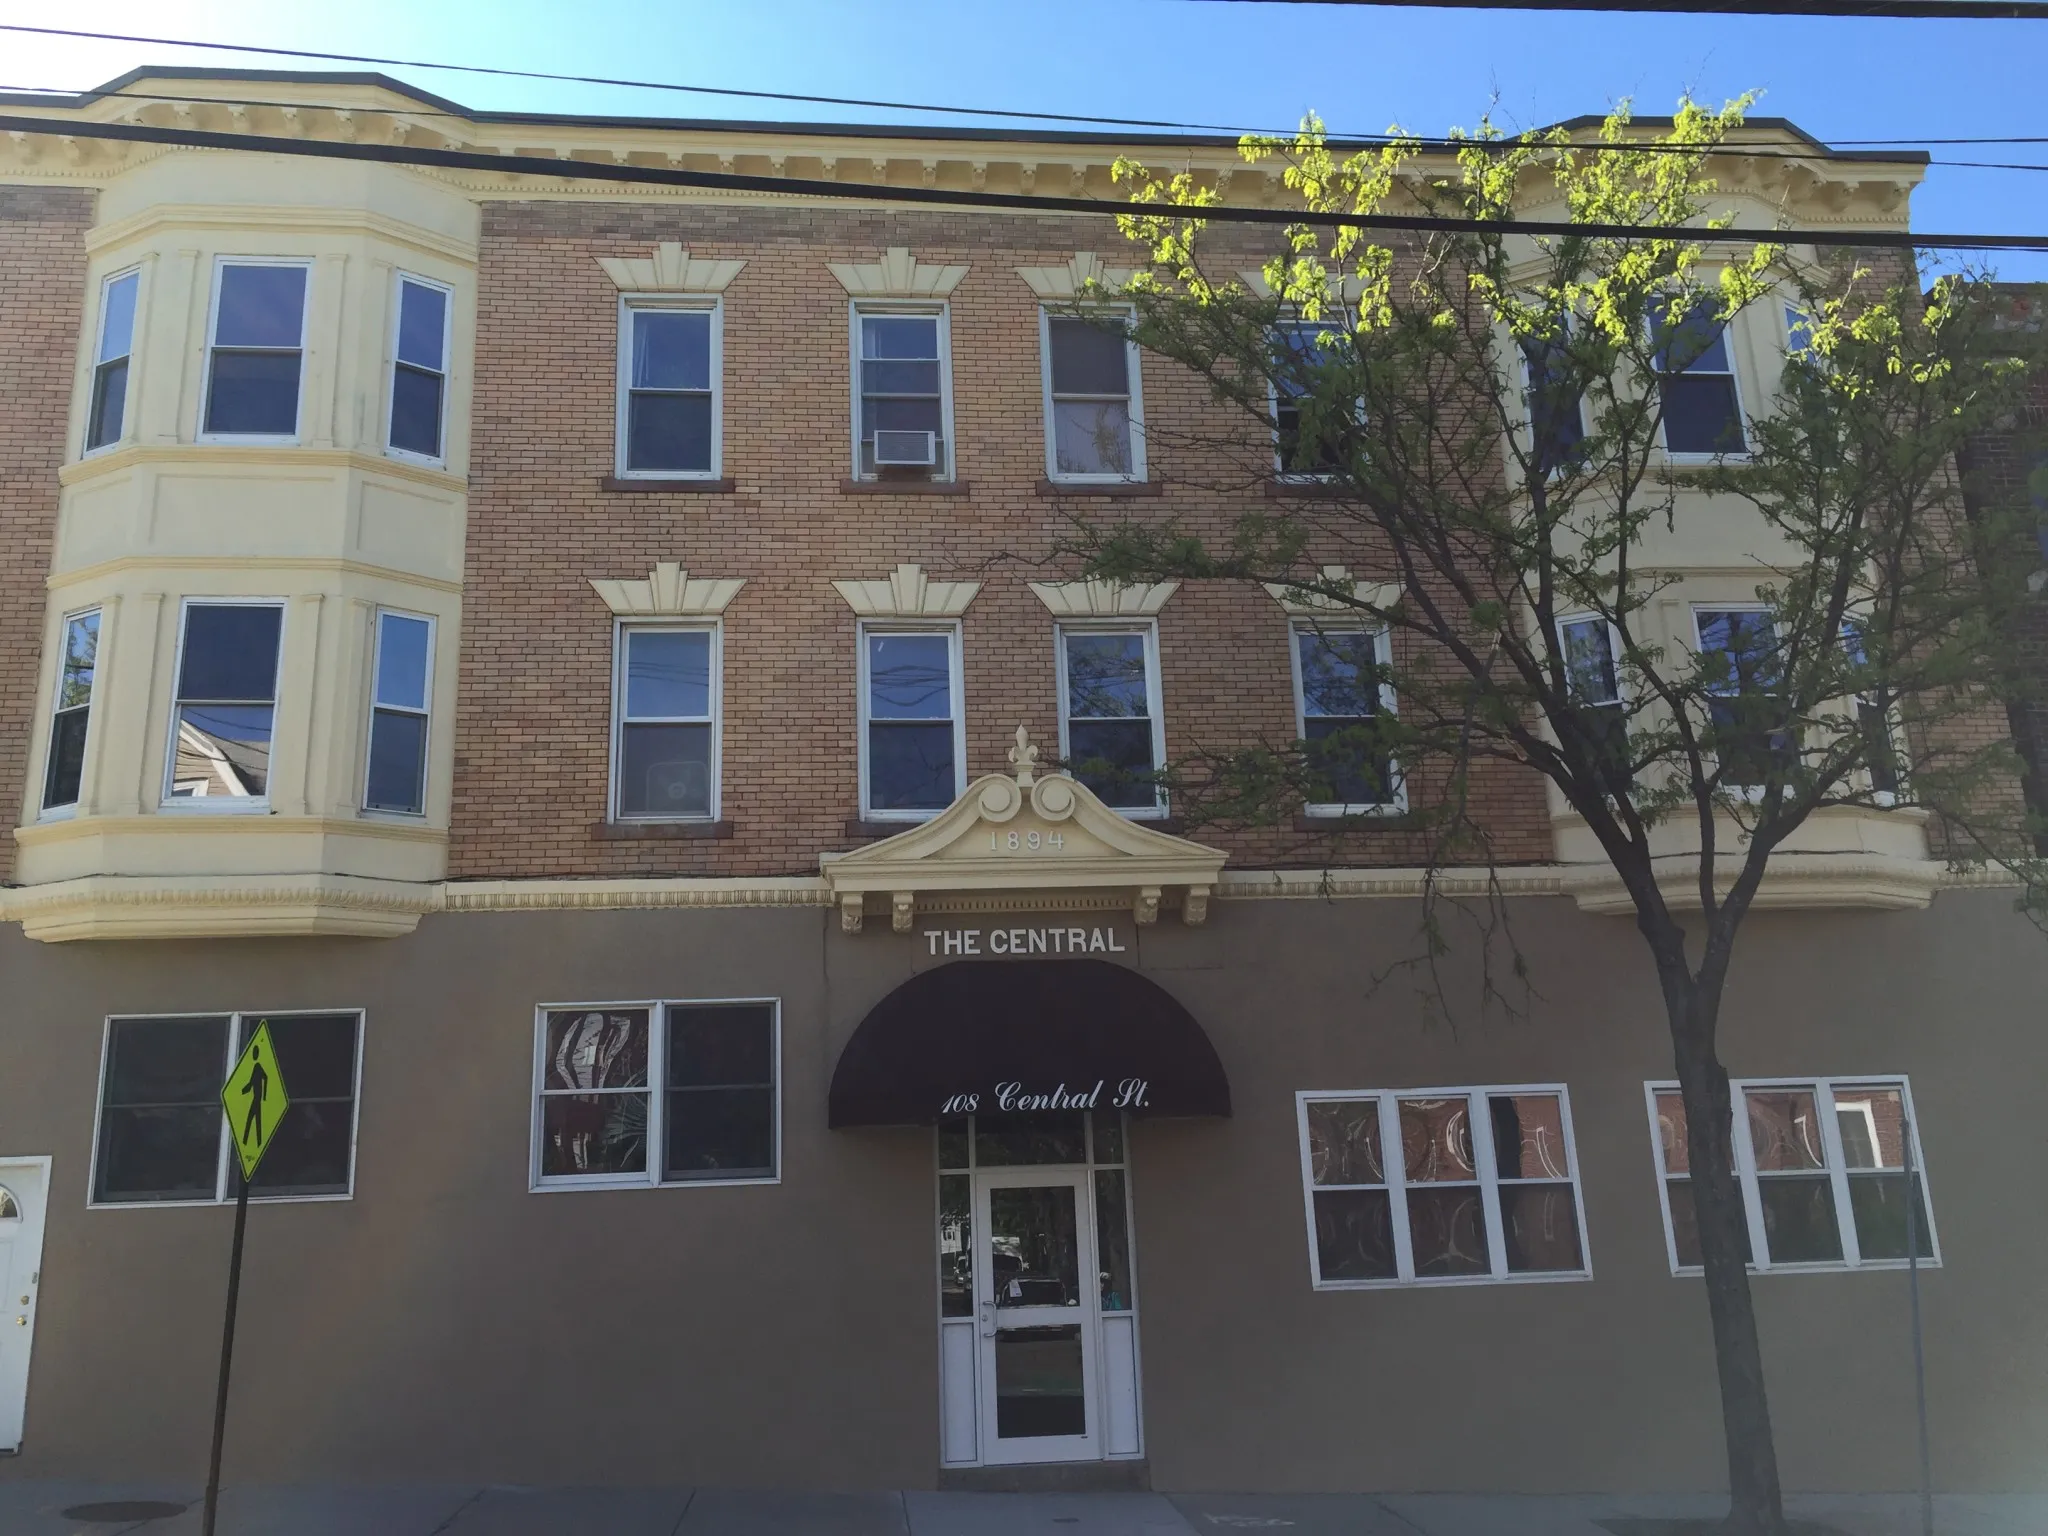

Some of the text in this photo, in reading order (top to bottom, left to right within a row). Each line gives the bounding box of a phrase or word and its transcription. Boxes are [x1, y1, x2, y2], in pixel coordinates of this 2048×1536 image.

[990, 830, 1065, 851] 1894
[924, 928, 1126, 955] THE CENTRAL
[941, 1078, 1150, 1113] 108 Central St.
